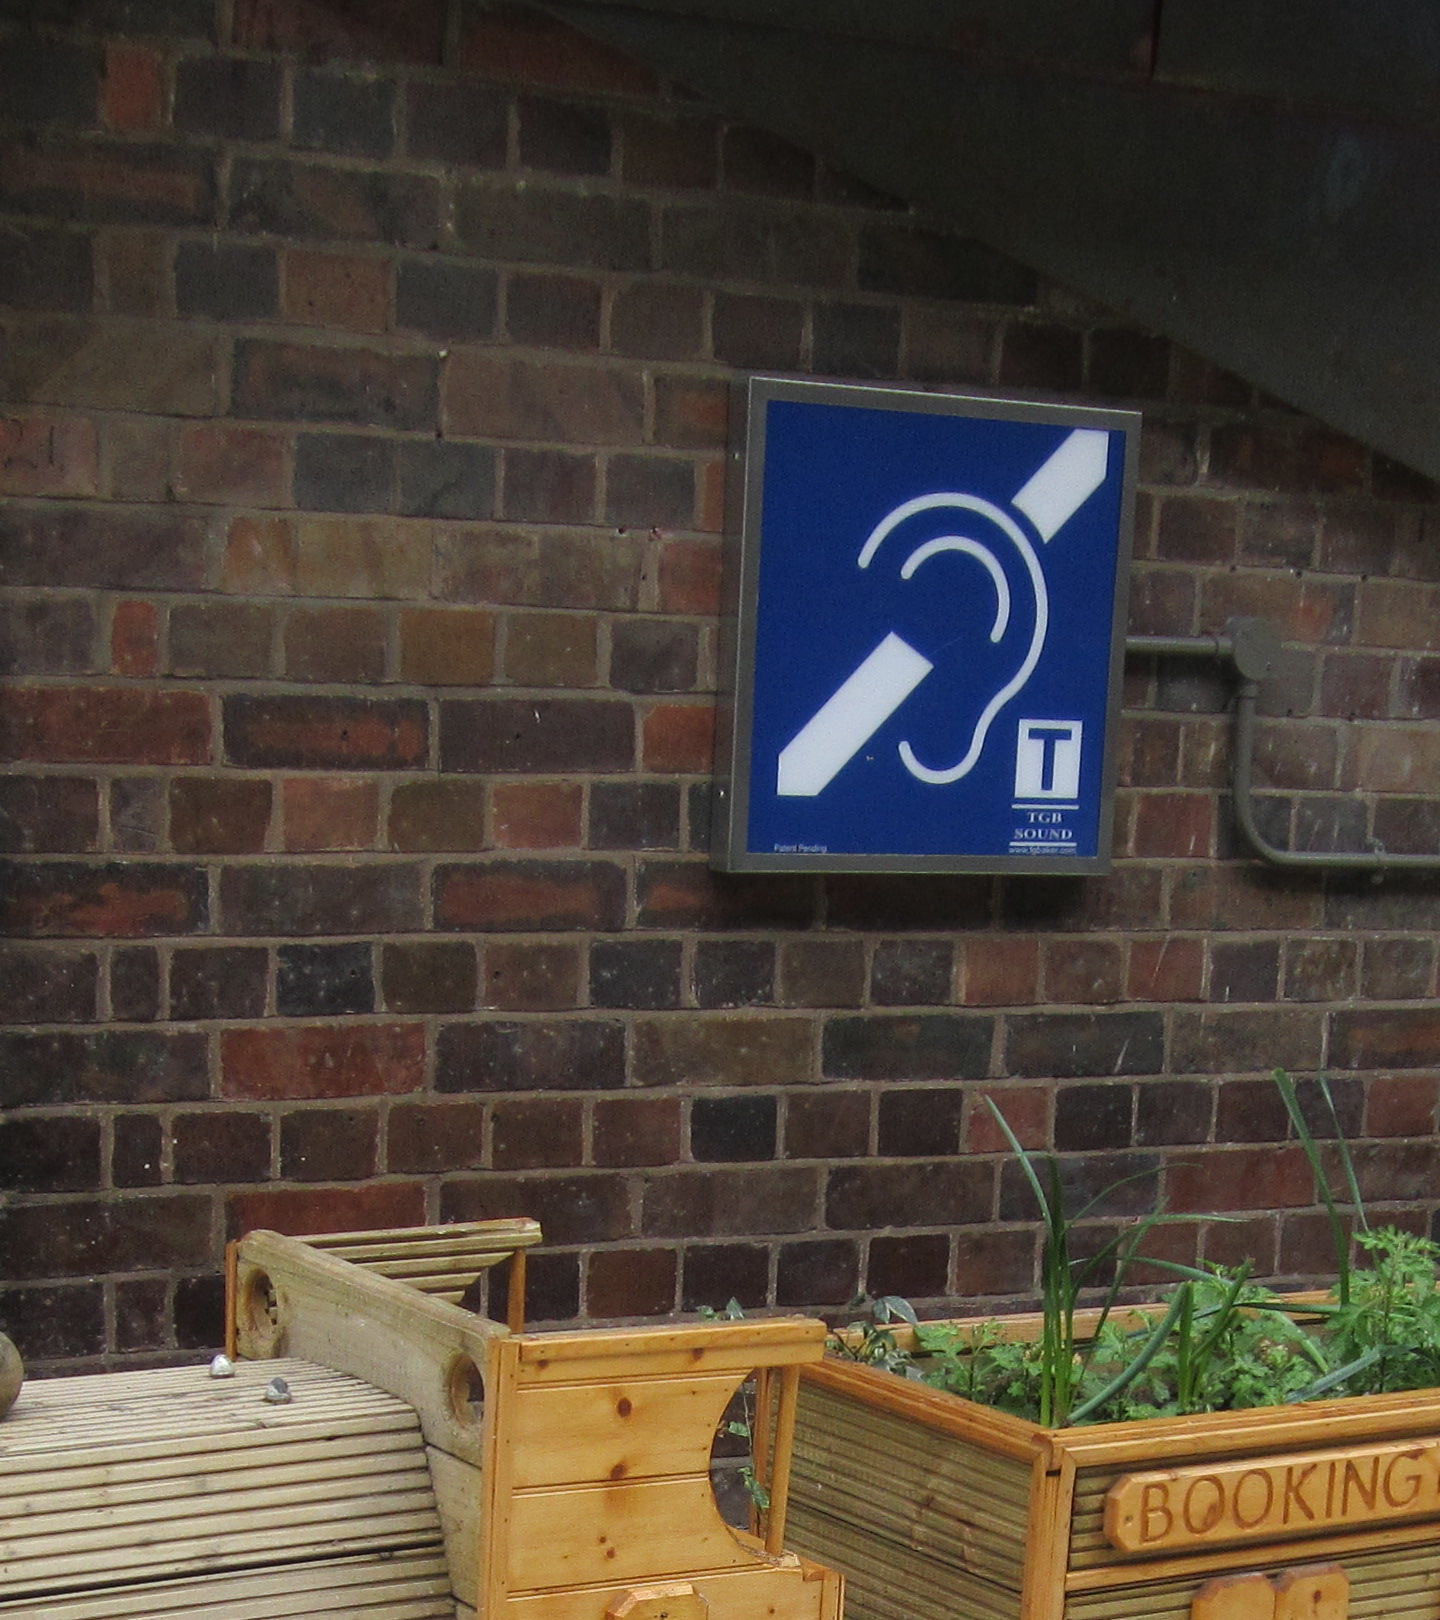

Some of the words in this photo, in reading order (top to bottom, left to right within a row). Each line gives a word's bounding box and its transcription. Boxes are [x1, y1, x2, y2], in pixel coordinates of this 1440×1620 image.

[1028, 729, 1072, 791] T
[1013, 828, 1073, 840] SOUND
[1027, 811, 1063, 824] TGB
[1138, 1447, 1423, 1544] BOOKING
